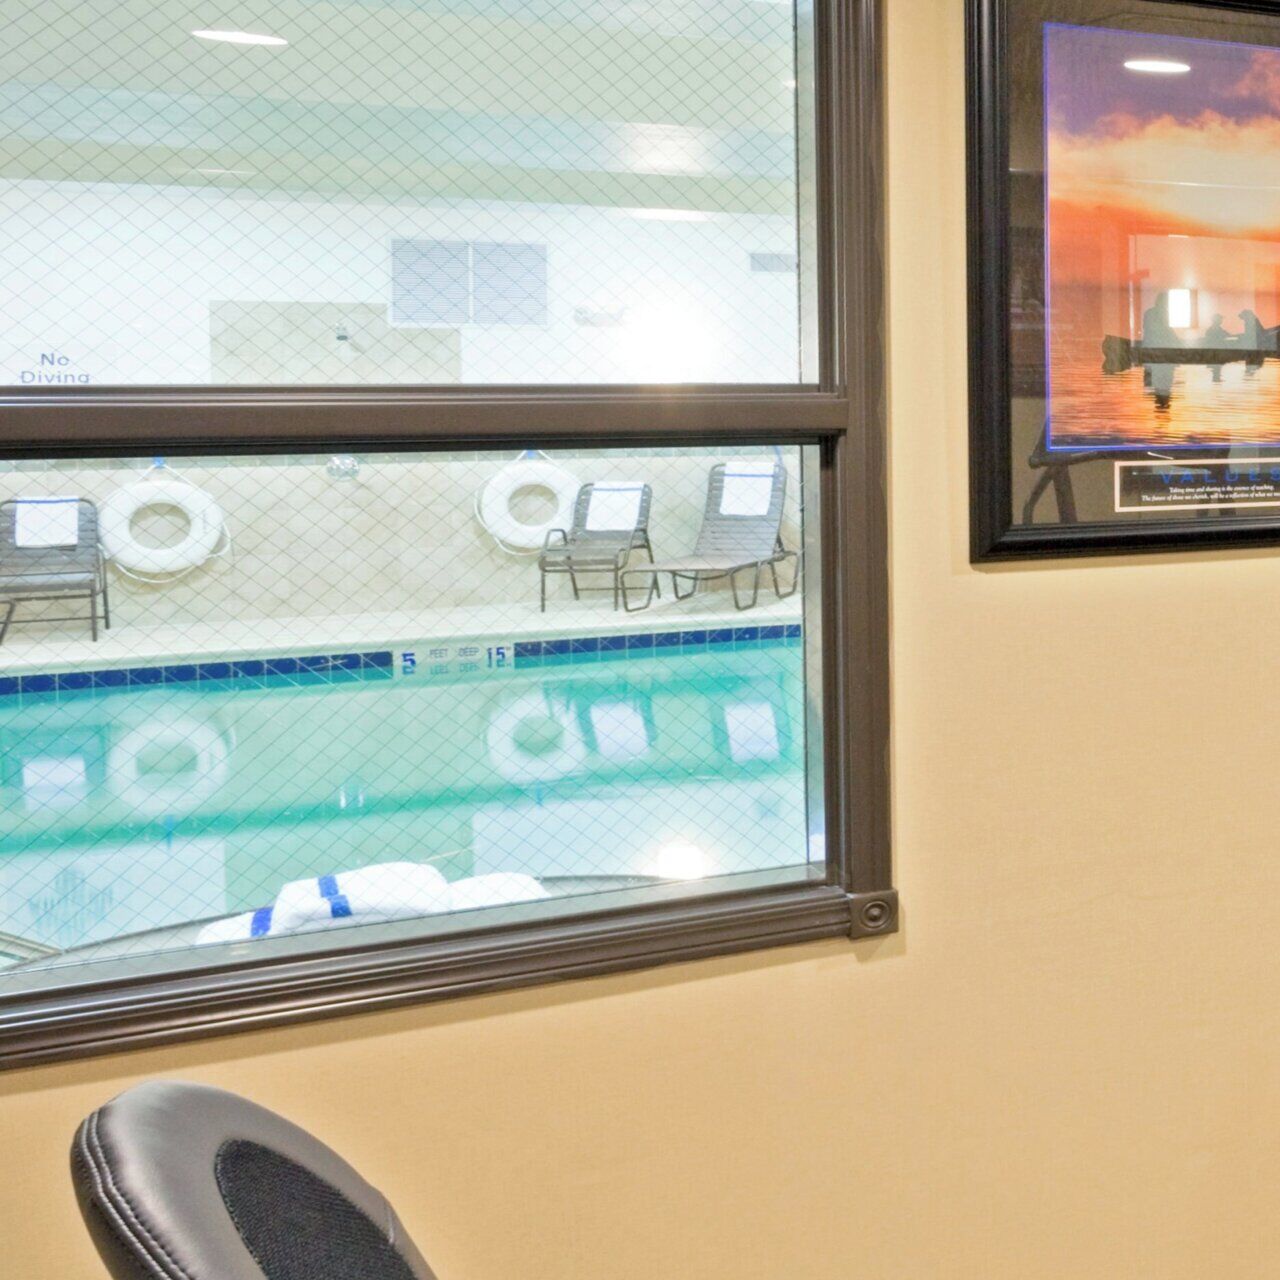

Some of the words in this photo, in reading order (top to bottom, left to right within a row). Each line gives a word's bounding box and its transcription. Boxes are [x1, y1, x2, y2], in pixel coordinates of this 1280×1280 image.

[41, 352, 69, 366] No
[21, 370, 90, 384] Diving
[401, 652, 416, 667] 5
